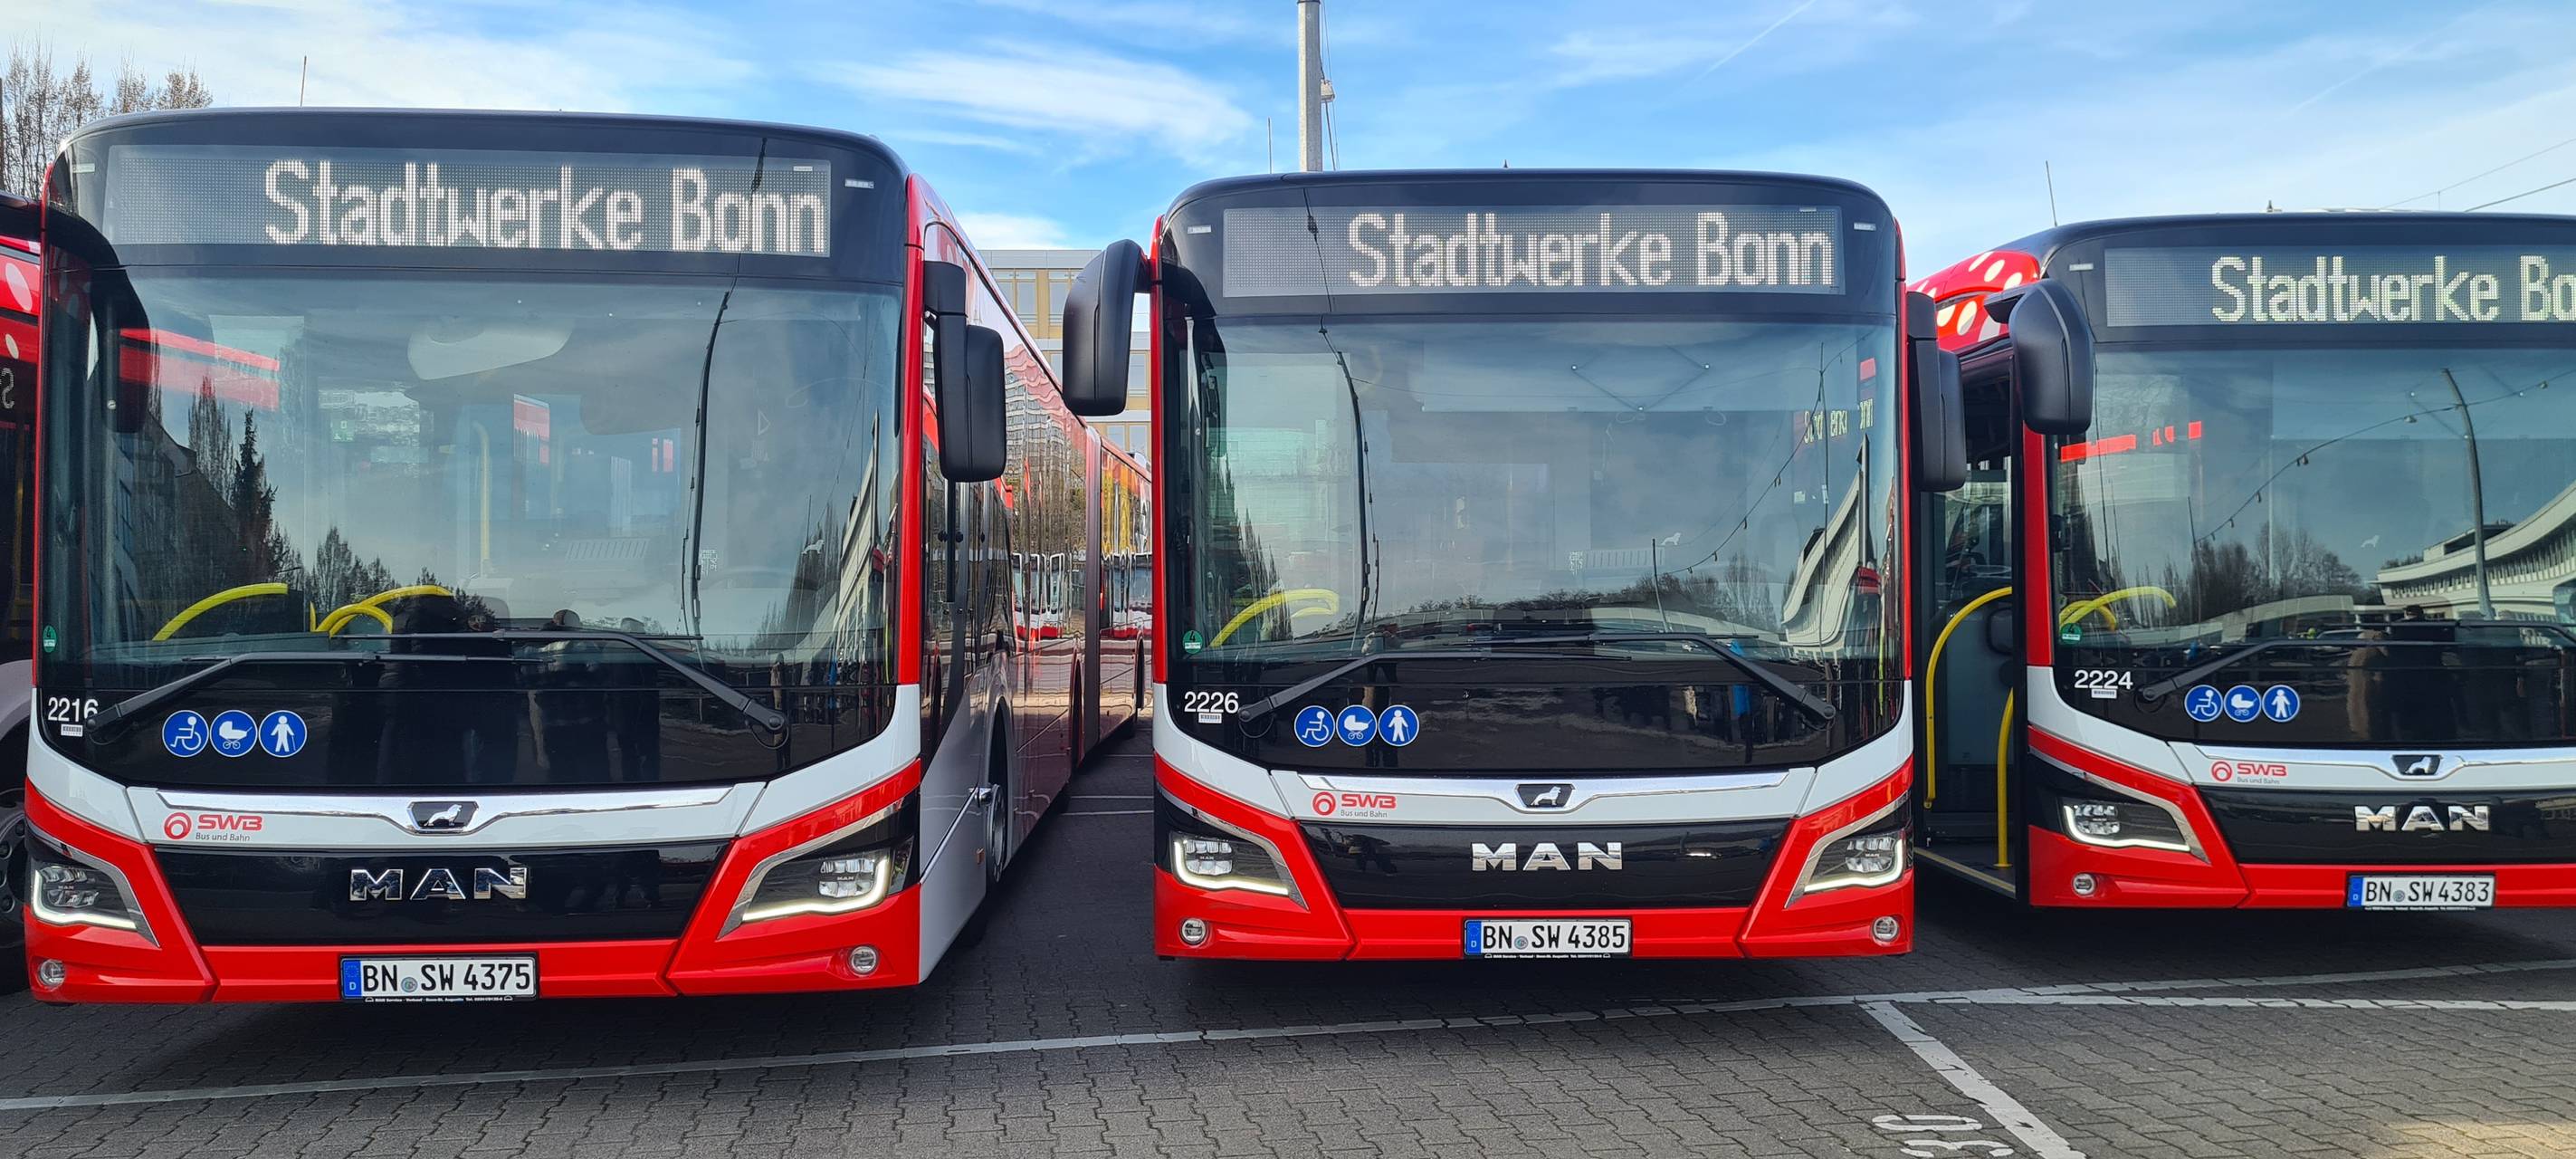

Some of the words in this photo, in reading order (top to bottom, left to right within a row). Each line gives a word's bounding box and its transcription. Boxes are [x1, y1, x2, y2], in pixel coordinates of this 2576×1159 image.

[265, 159, 643, 250] Stadtwerke
[673, 167, 825, 253] Bonn
[1349, 213, 1673, 287] Stadtwerke
[1696, 212, 1833, 286] Bonn
[2211, 255, 2500, 321] Stadtwerke
[2075, 670, 2133, 689] 2224
[48, 696, 99, 723] 2216
[1184, 691, 1239, 714] 2226
[2237, 763, 2287, 776] SWB
[1340, 793, 1397, 809] SWB
[197, 814, 262, 831] SWB
[1354, 809, 1368, 818] und
[2354, 806, 2489, 831] MAN
[196, 832, 209, 840] Bus
[212, 833, 227, 841] und
[230, 833, 250, 842] Bahn
[1472, 842, 1622, 871] MAN
[349, 867, 527, 901] MAN
[2365, 881, 2391, 903] BN
[2408, 881, 2434, 903] SW
[2438, 881, 2489, 903] 4383
[1483, 925, 1512, 949] BN
[1531, 925, 1560, 949] SW
[1568, 925, 1626, 949] 4385
[349, 982, 356, 991] D
[363, 964, 397, 992] BN
[421, 963, 453, 991] SW
[463, 963, 530, 991] 4375
